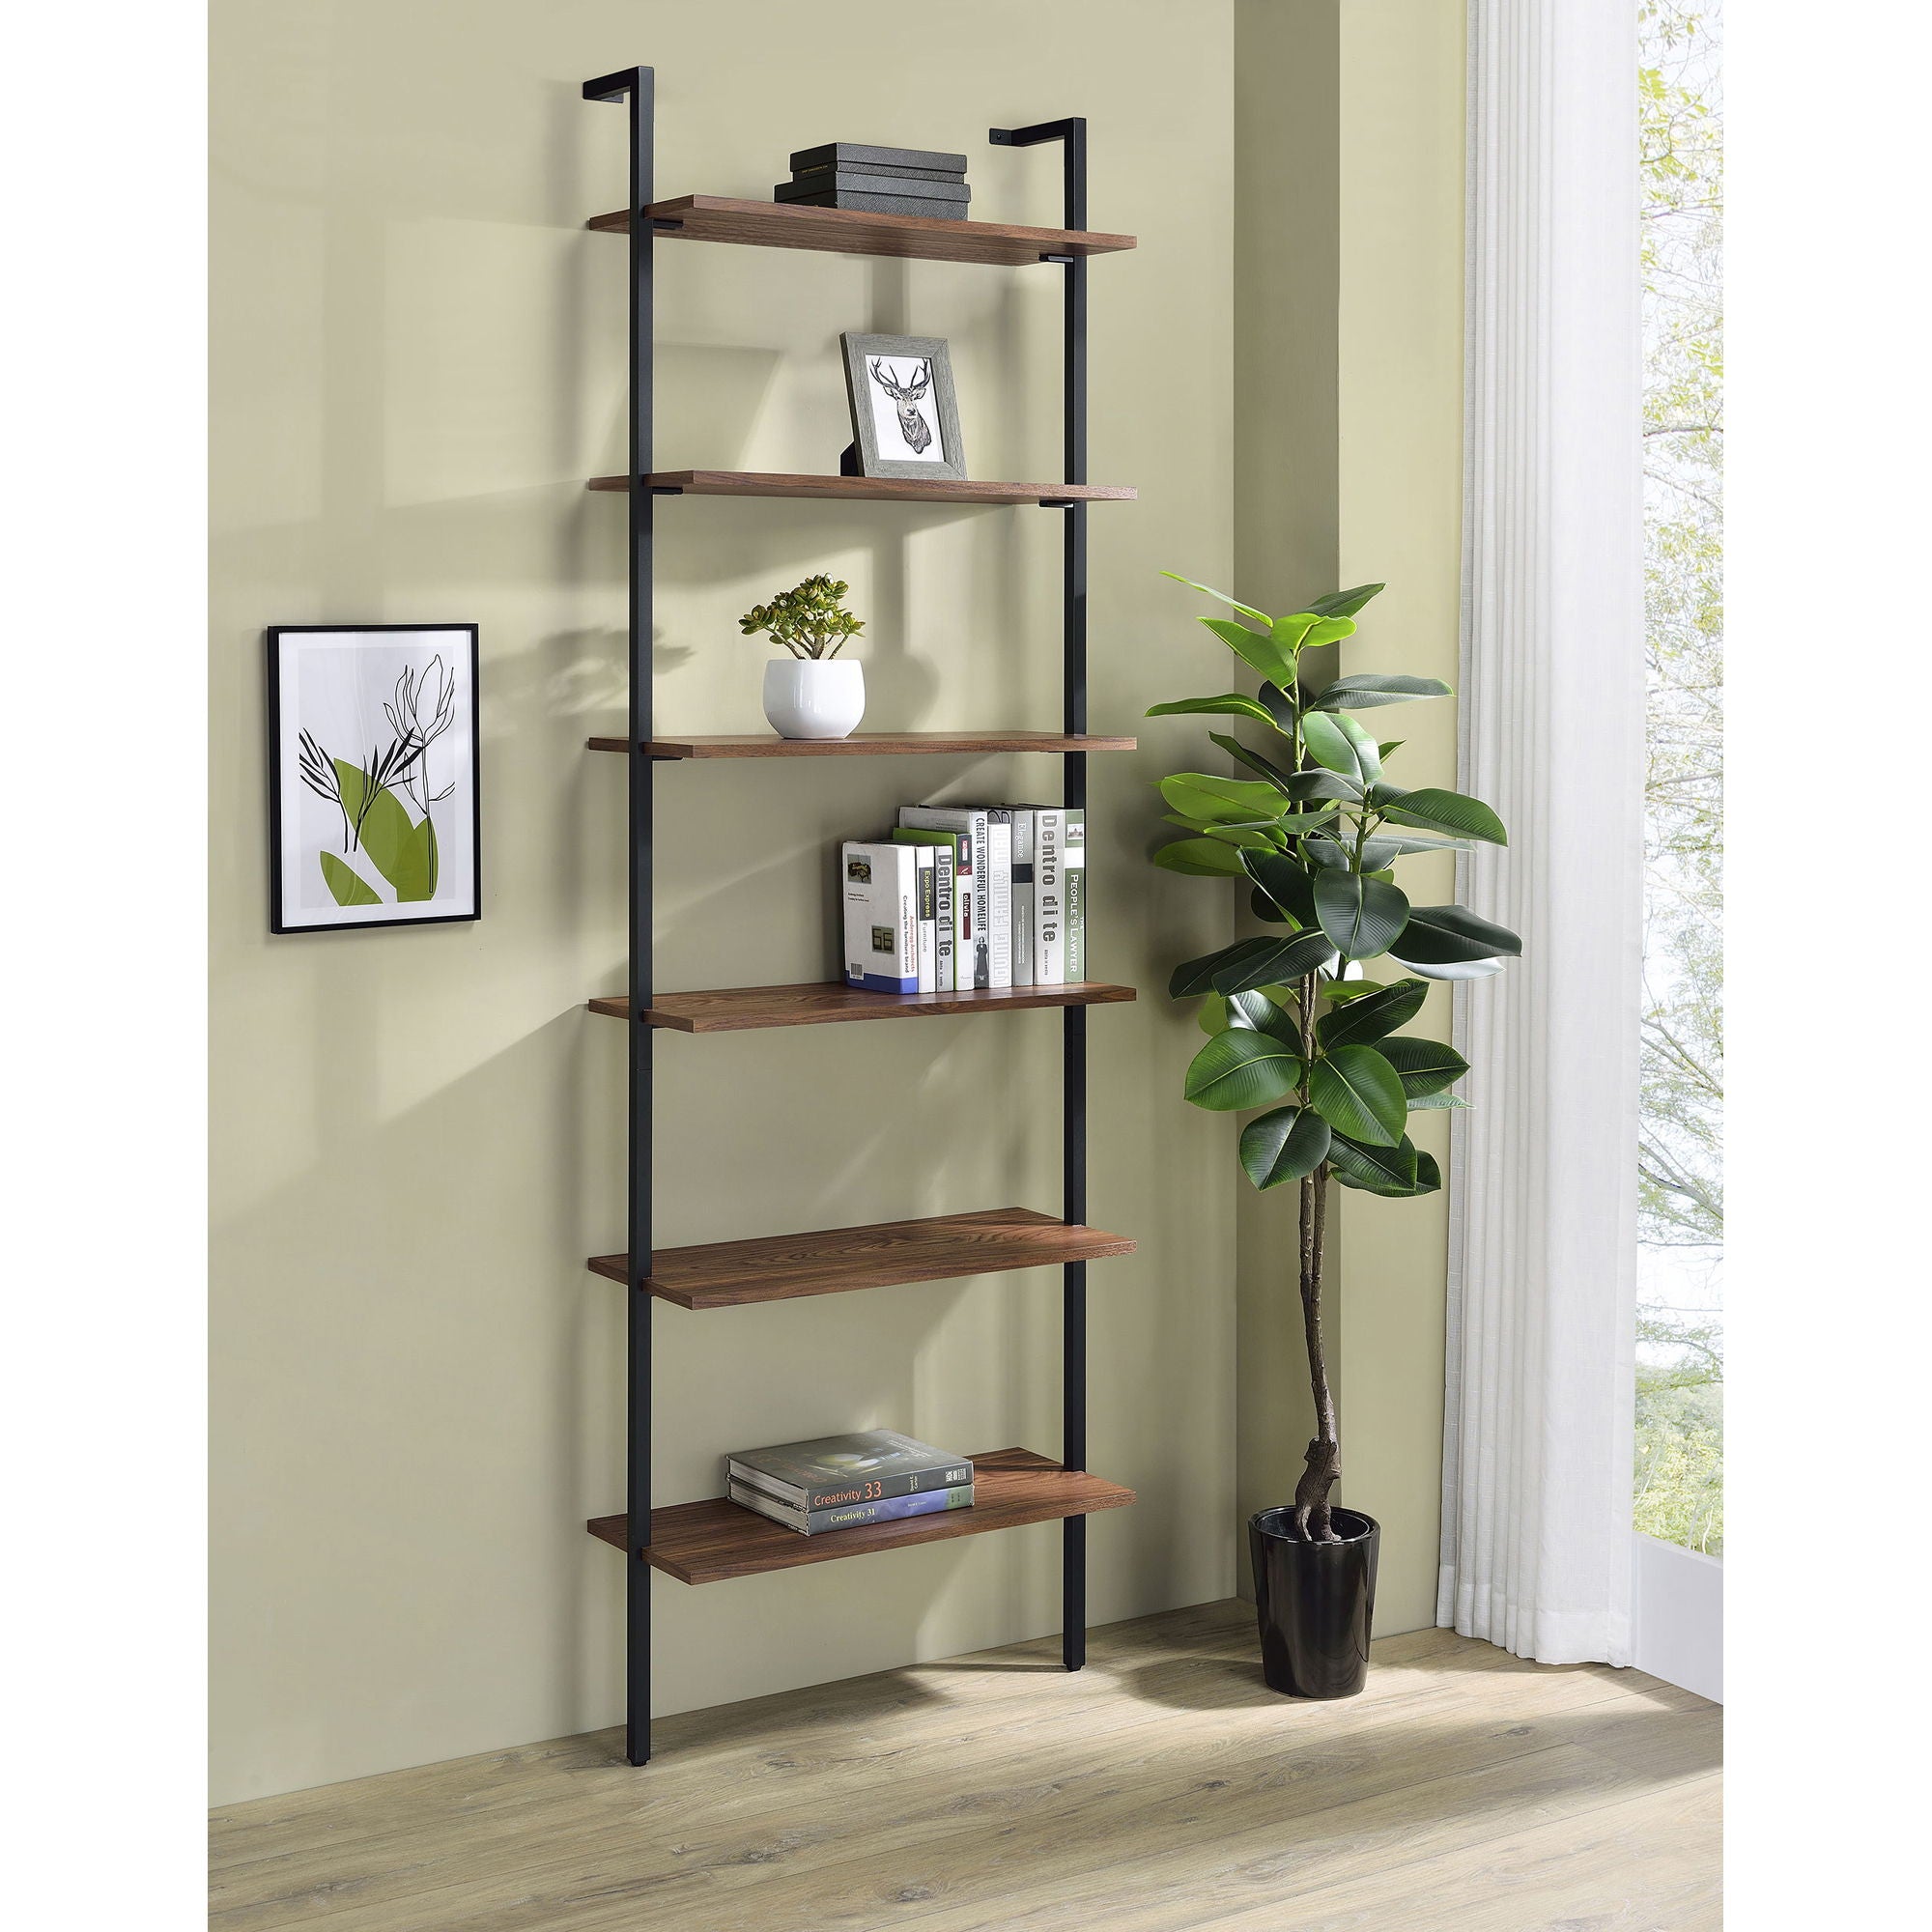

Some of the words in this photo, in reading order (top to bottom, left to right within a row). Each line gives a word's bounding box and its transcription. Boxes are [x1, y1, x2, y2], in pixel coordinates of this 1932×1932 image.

[976, 817, 985, 844] CREATE
[1015, 822, 1027, 858] Elegance
[1042, 815, 1058, 885] Dentro
[938, 855, 952, 911] Dentro
[977, 847, 986, 893] WONDERFUL
[977, 895, 986, 931] HOMELIFE
[1042, 895, 1059, 916] di
[1069, 874, 1079, 925] PEOPLE'S
[938, 916, 953, 932] di
[1042, 923, 1058, 942] te
[938, 940, 952, 956] te
[1069, 927, 1079, 973] LAWYER
[814, 1490, 862, 1507] Creativity
[865, 1481, 882, 1499] 33
[830, 1510, 866, 1523] Creativity
[867, 1508, 875, 1517] 31
